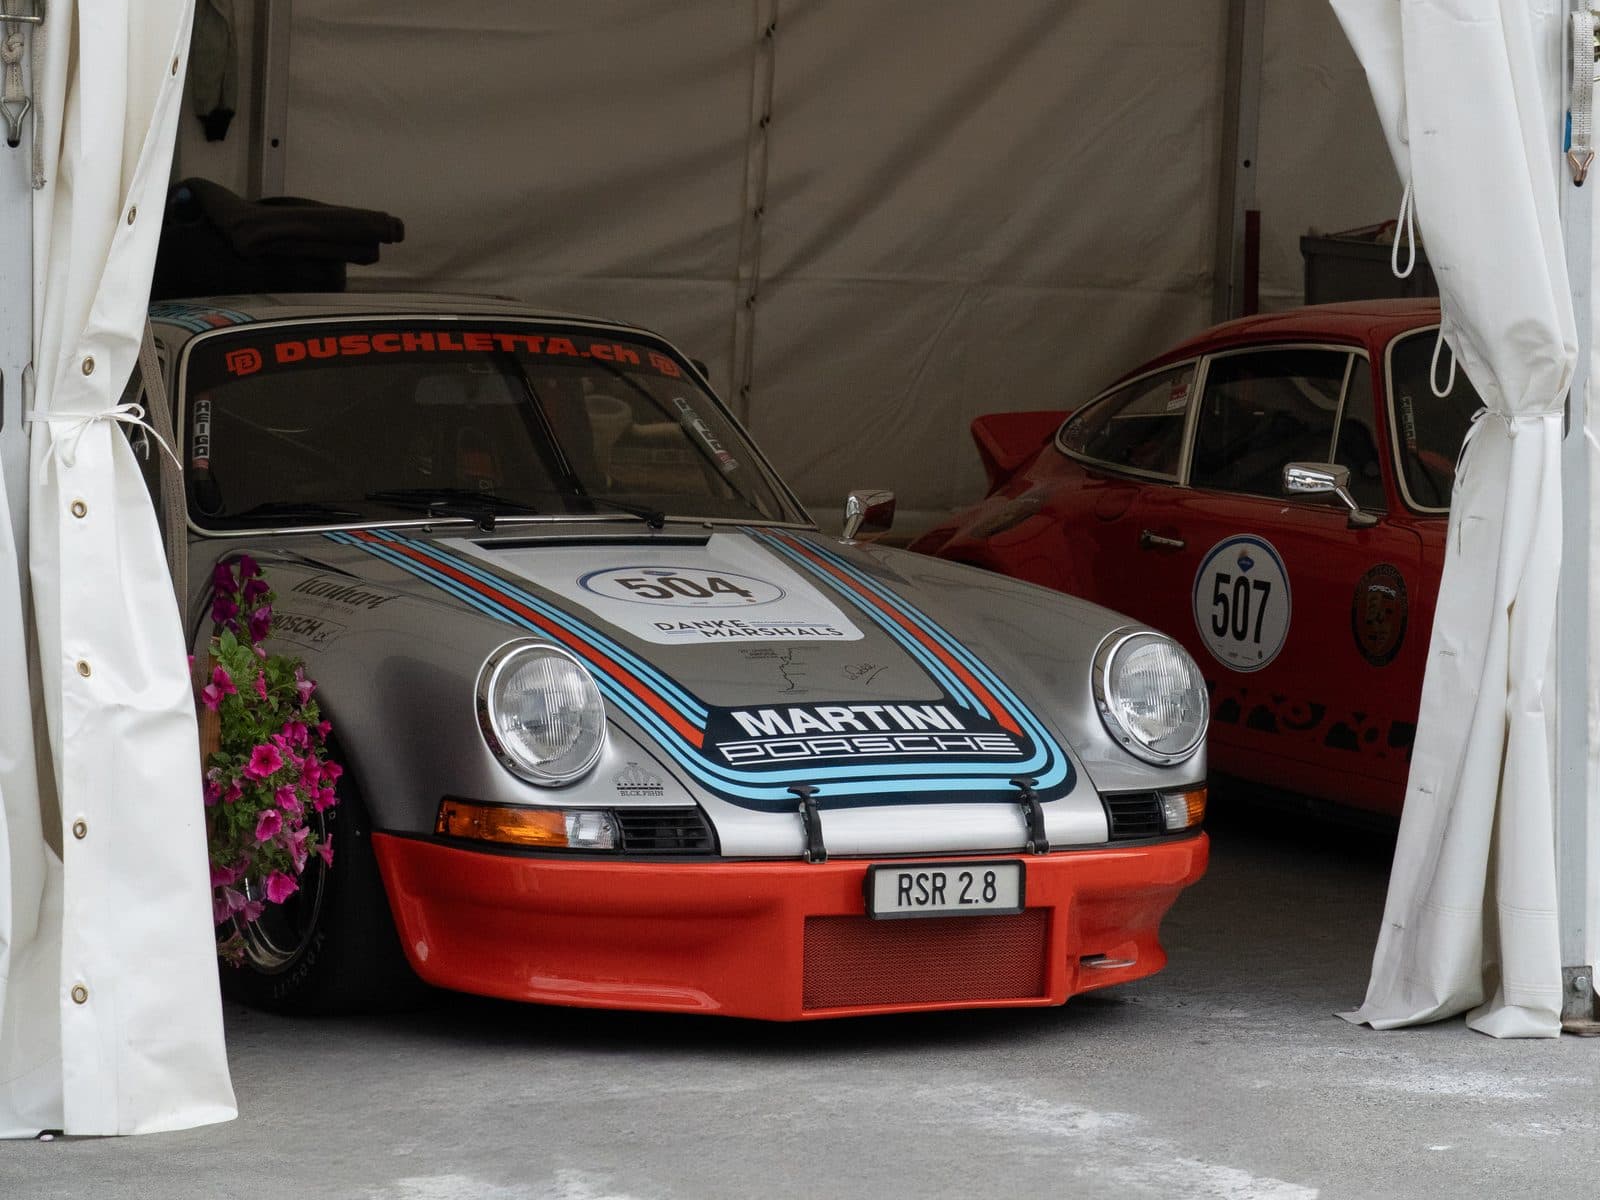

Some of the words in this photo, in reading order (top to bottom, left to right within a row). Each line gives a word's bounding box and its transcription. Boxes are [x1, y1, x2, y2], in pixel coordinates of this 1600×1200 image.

[274, 332, 639, 364] DUSCHLETTA.ch
[613, 577, 754, 599] 504
[1211, 573, 1271, 644] 507
[653, 619, 749, 631] DANKE
[703, 627, 845, 638] MARSHALS
[730, 705, 966, 737] MARTINI
[718, 737, 1020, 762] PORSCHE
[897, 872, 947, 906] RSR
[958, 871, 997, 904] 2.8
